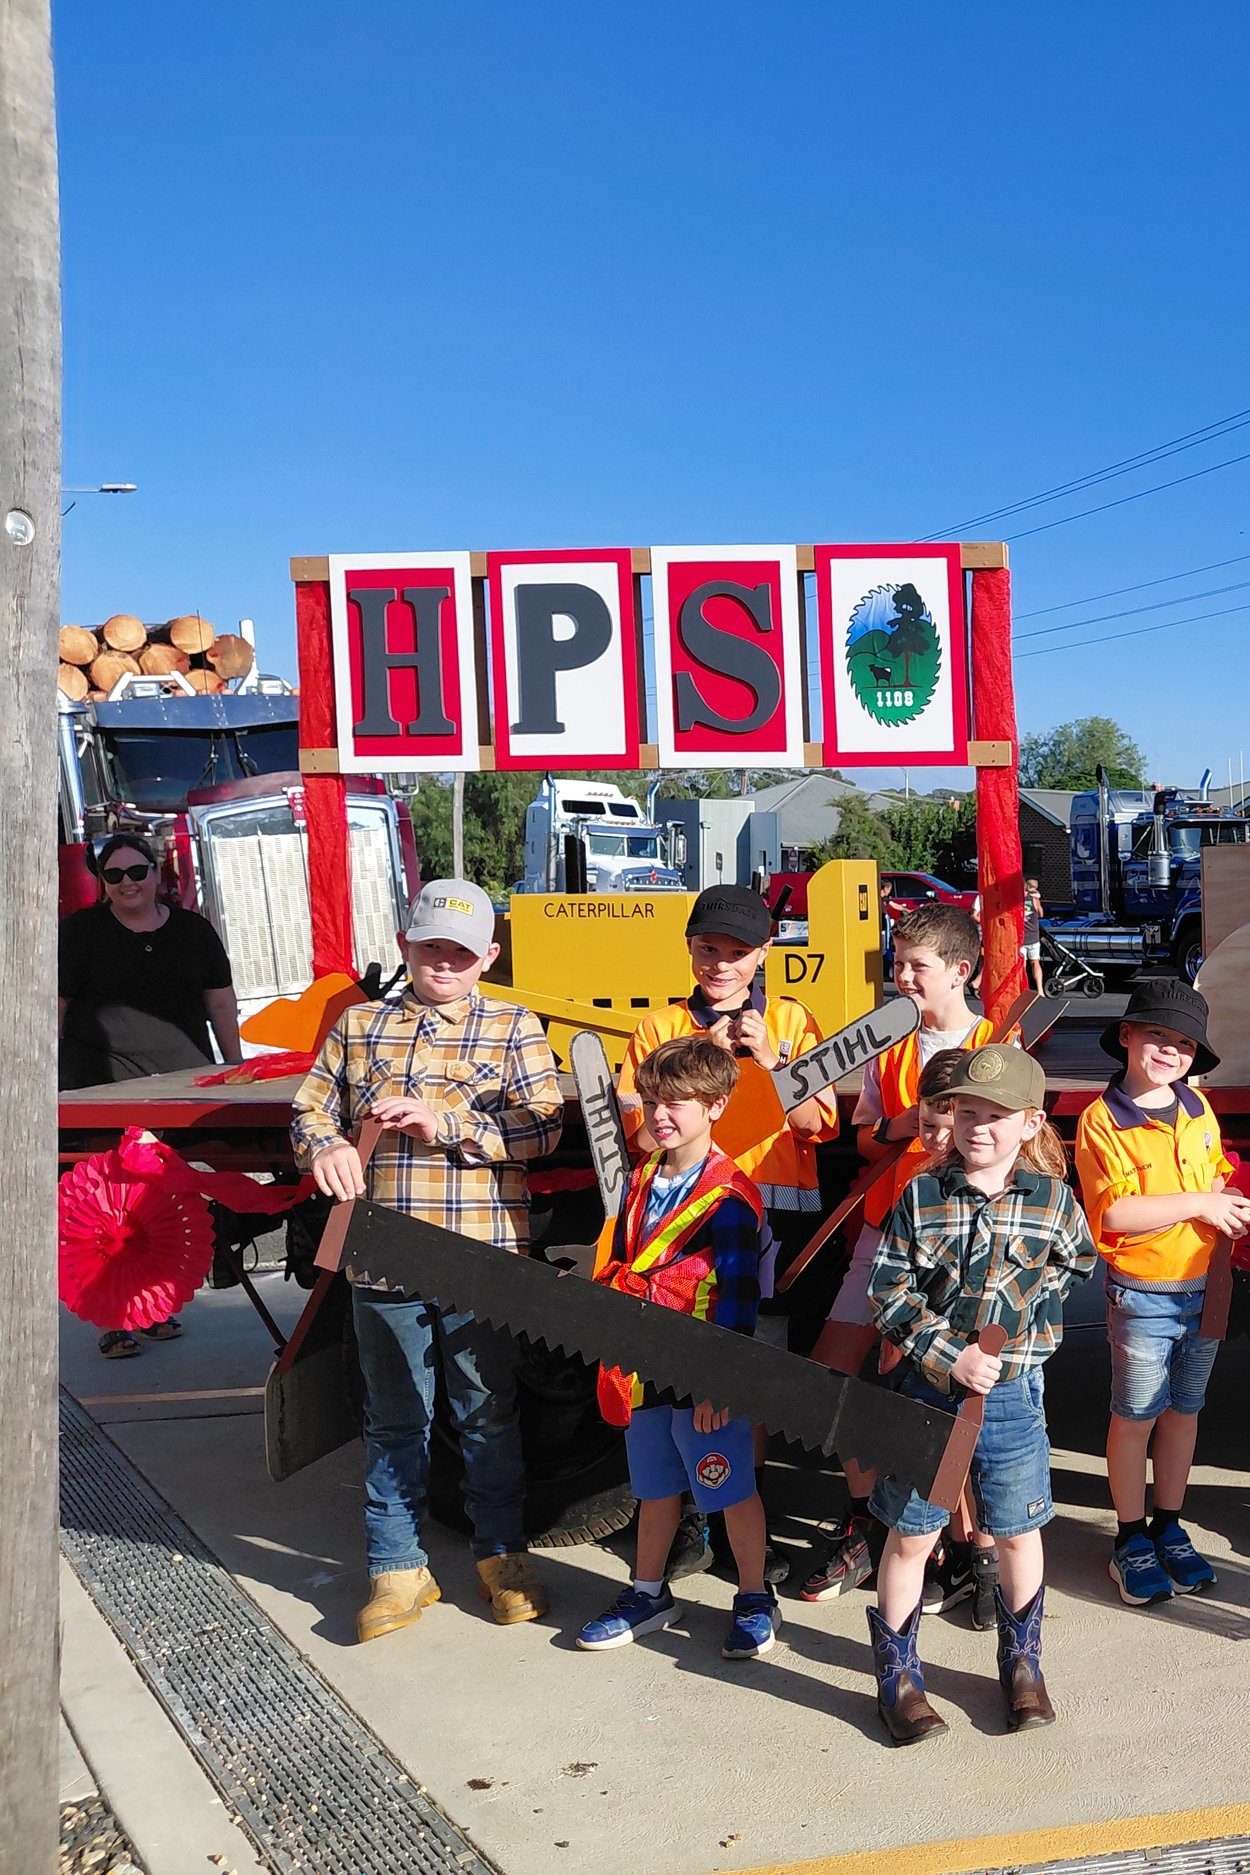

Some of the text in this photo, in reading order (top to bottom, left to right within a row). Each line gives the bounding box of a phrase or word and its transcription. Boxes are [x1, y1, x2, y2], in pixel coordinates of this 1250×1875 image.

[876, 690, 914, 708] 1108
[449, 899, 471, 910] CAT
[544, 902, 655, 918] CATERPILLAR
[784, 953, 825, 984] D7
[790, 1023, 892, 1101] STIHL
[585, 1074, 626, 1194] STIHL
